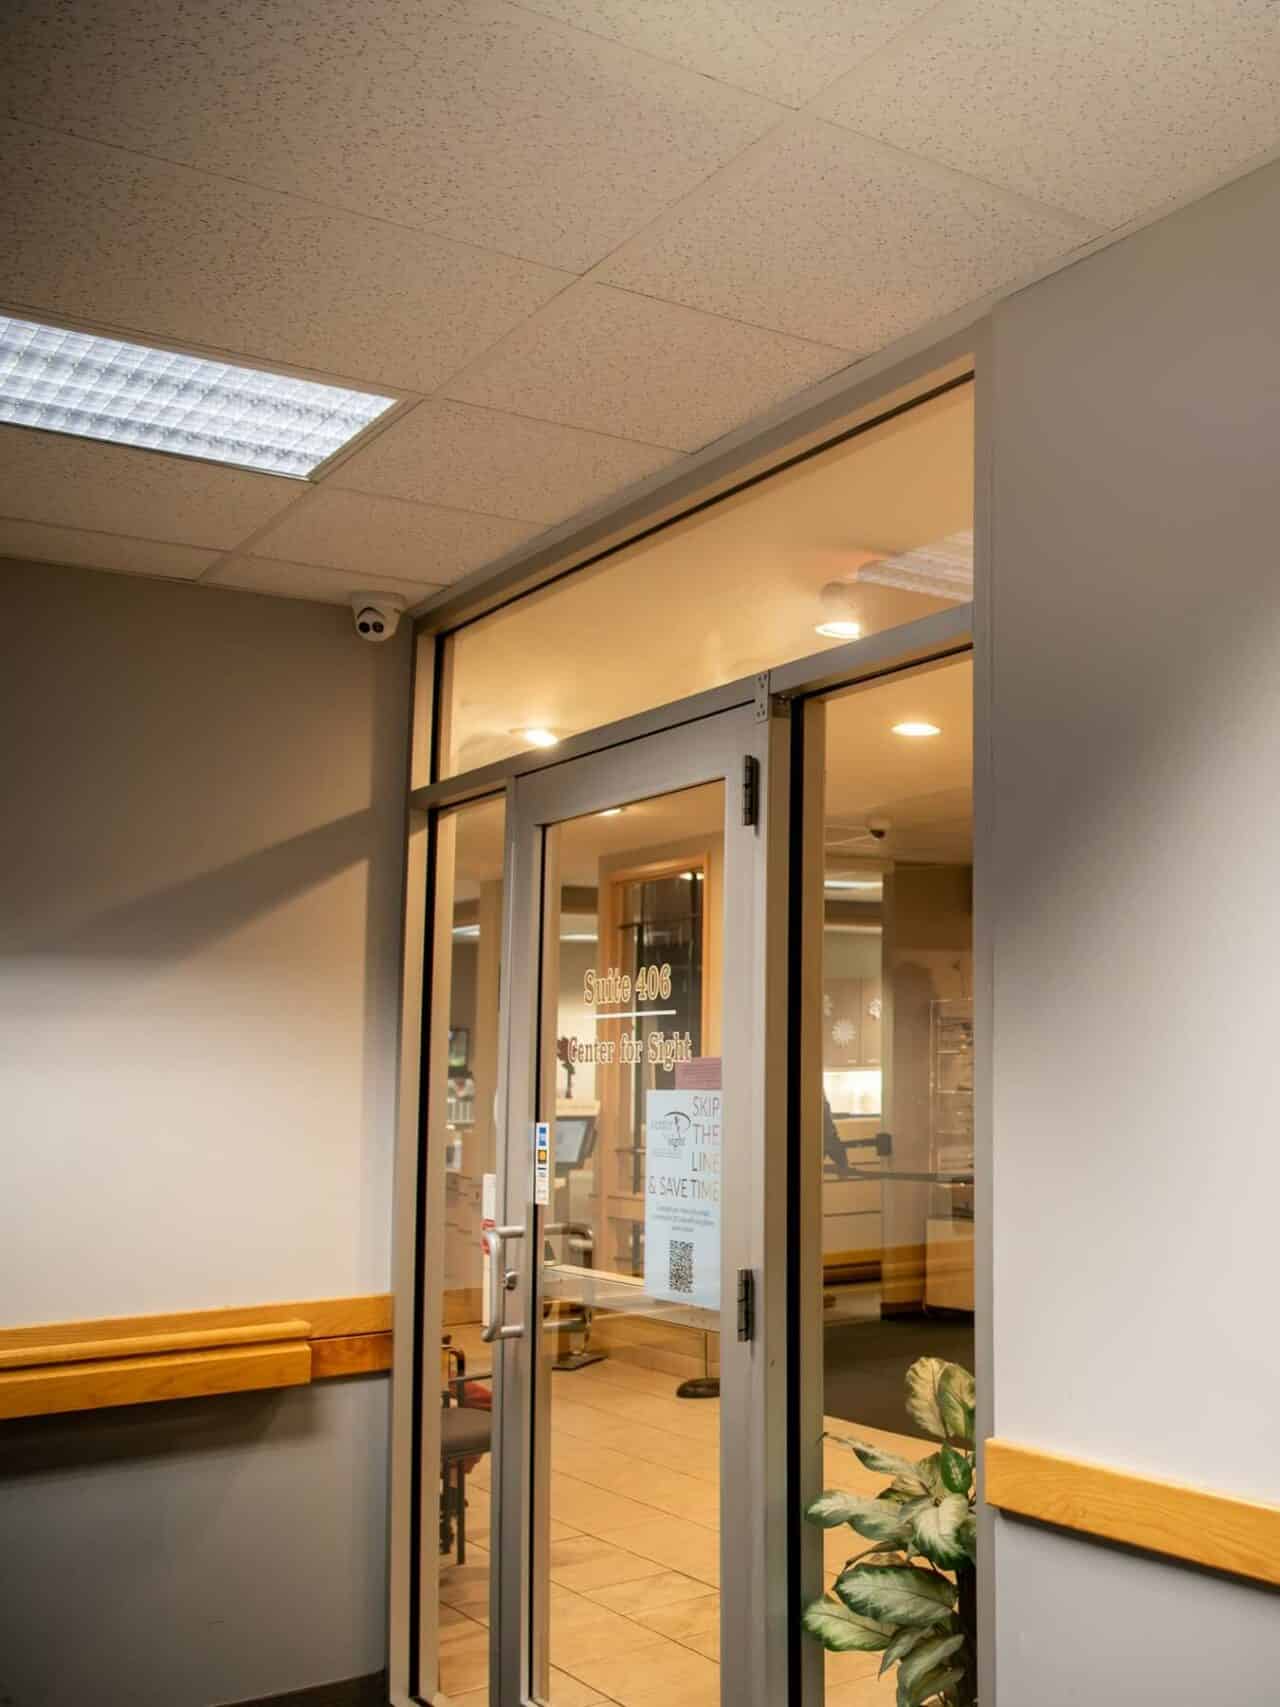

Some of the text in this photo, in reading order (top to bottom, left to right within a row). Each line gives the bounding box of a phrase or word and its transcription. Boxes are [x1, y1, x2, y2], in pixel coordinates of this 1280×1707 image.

[583, 963, 672, 1006] Suite 406
[567, 1031, 693, 1072] Center for Sight
[691, 1095, 720, 1119] SKIP
[692, 1123, 720, 1146] THE
[659, 1176, 688, 1198] SAVE
